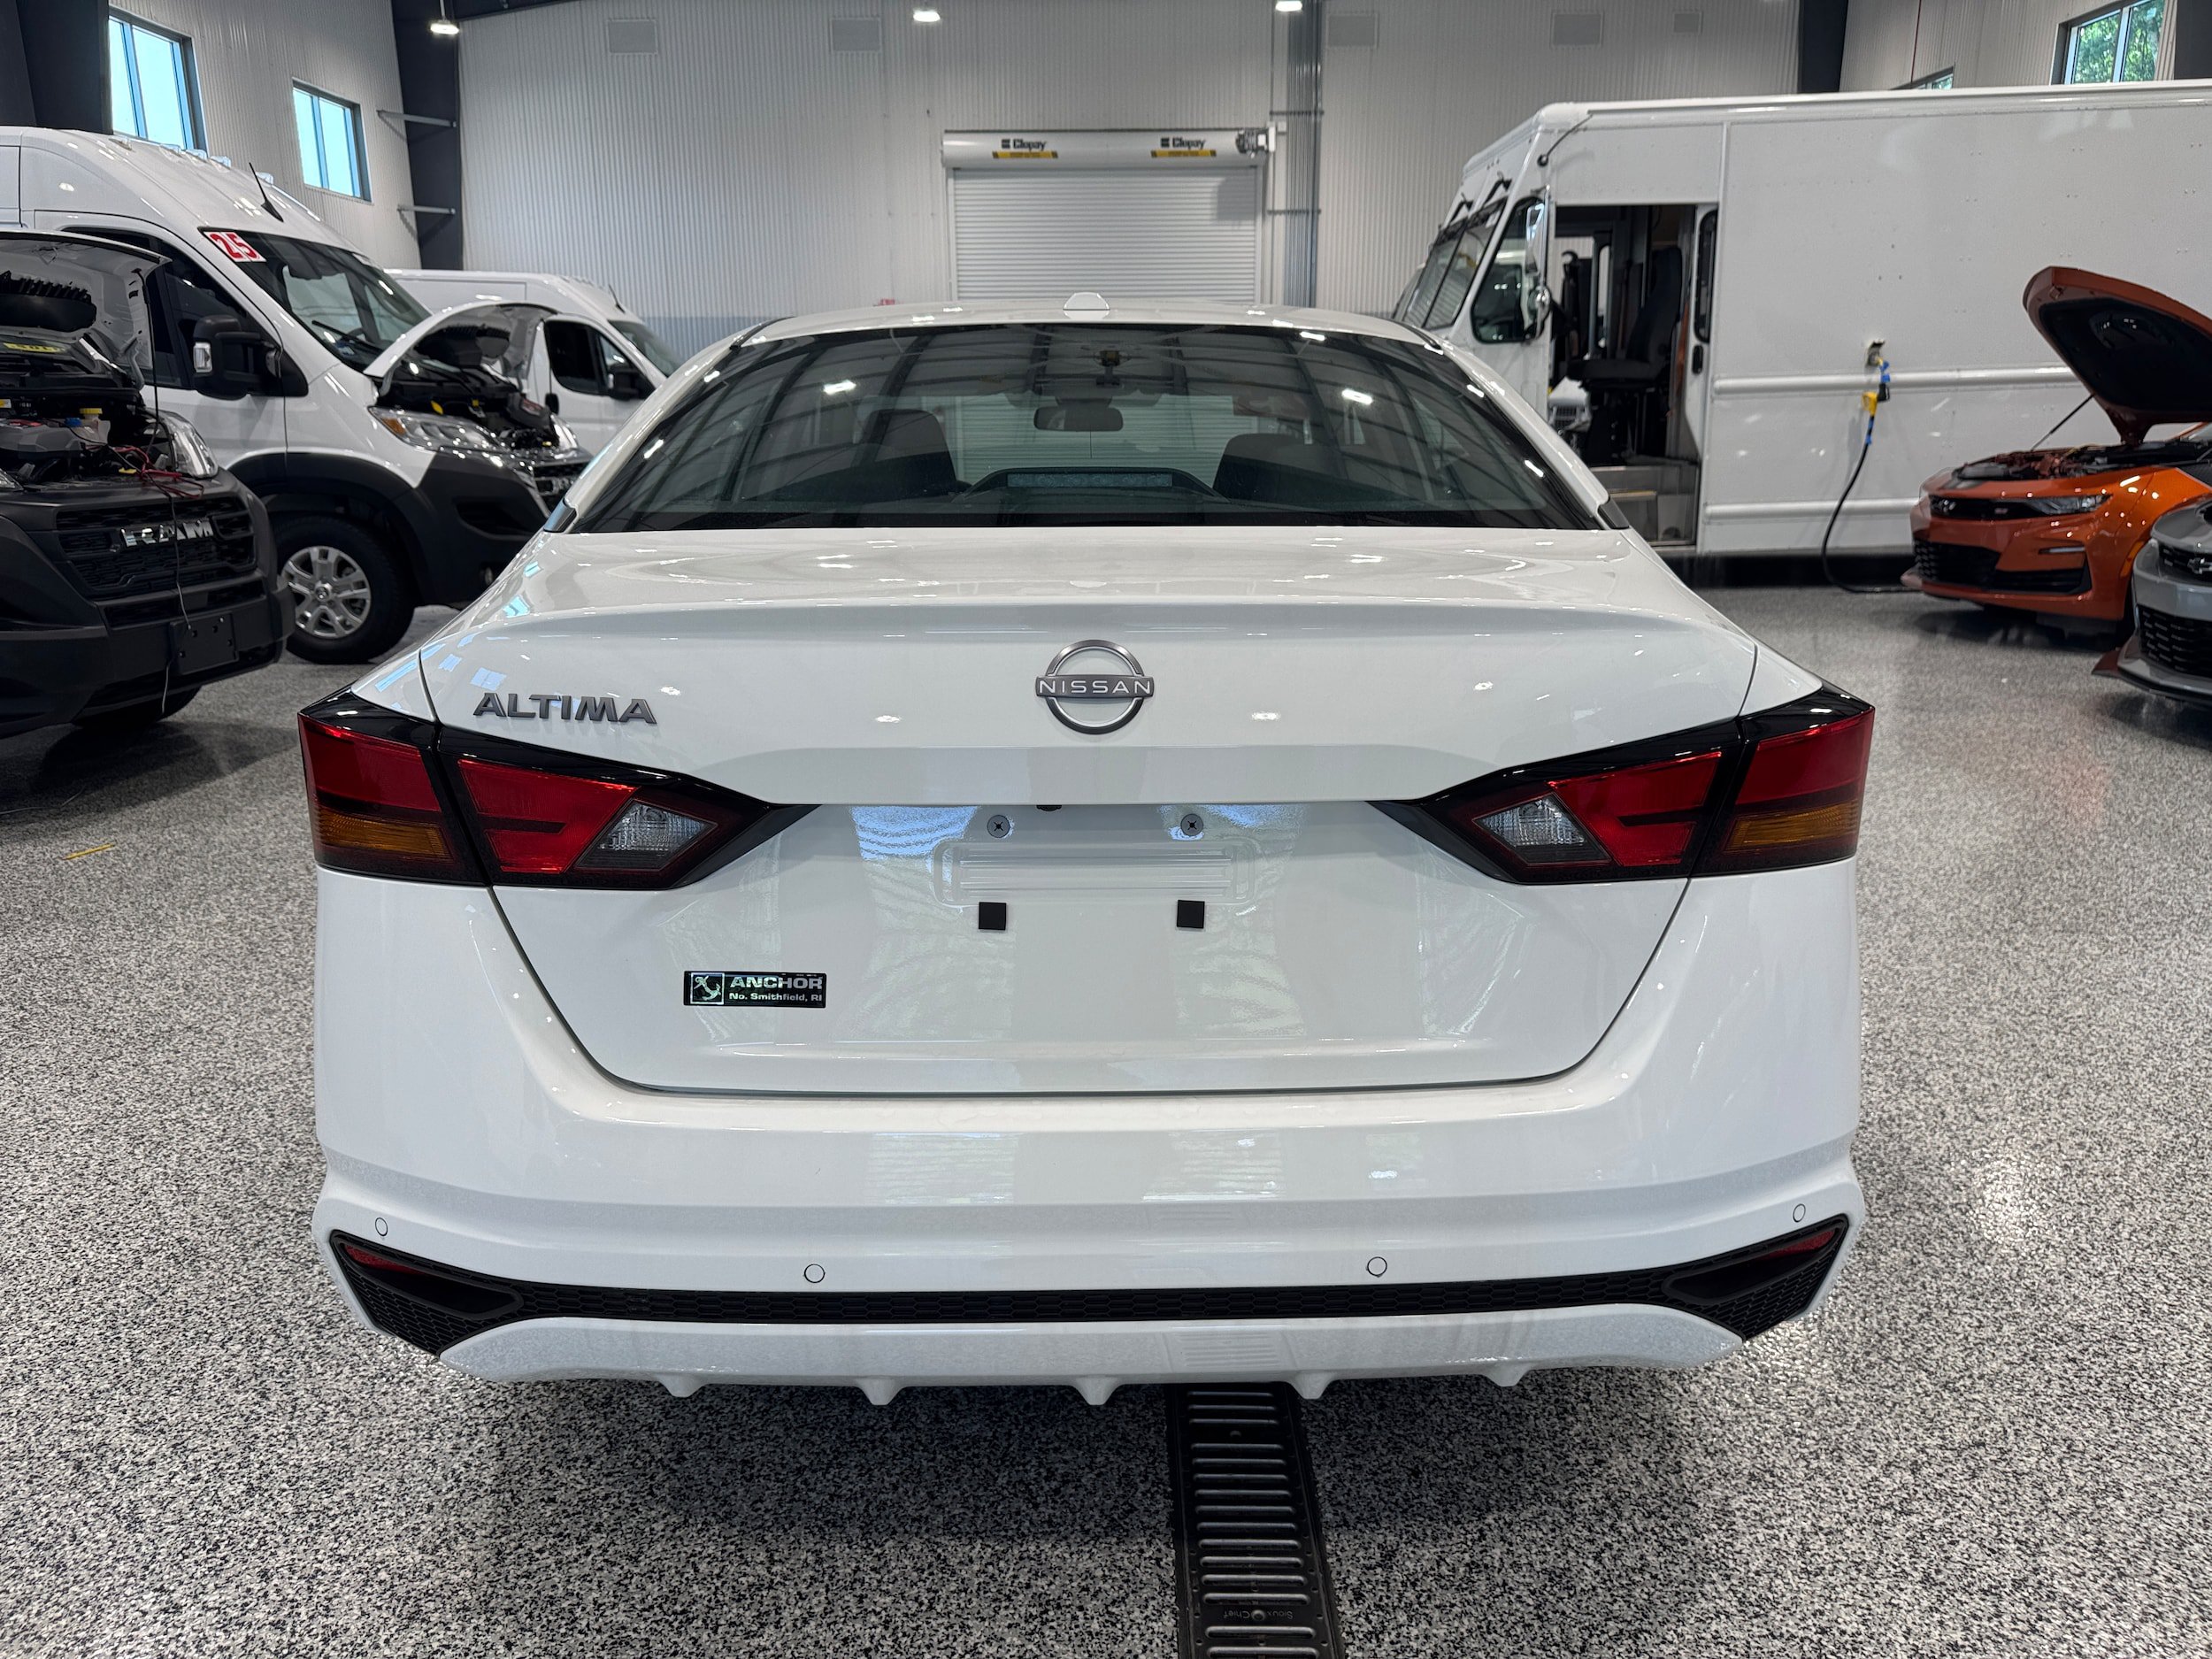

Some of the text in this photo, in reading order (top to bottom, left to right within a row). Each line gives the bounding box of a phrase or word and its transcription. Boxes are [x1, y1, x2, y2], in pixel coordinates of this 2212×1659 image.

[209, 233, 257, 259] 25
[120, 518, 214, 548] RAM
[1039, 680, 1151, 695] NISSAN
[472, 692, 657, 725] ALTIMA
[729, 975, 823, 990] ANCHOR
[728, 992, 749, 1001] No.
[750, 992, 809, 1002] Smithfield,
[1223, 1610, 1294, 1620] Sioux Chief
